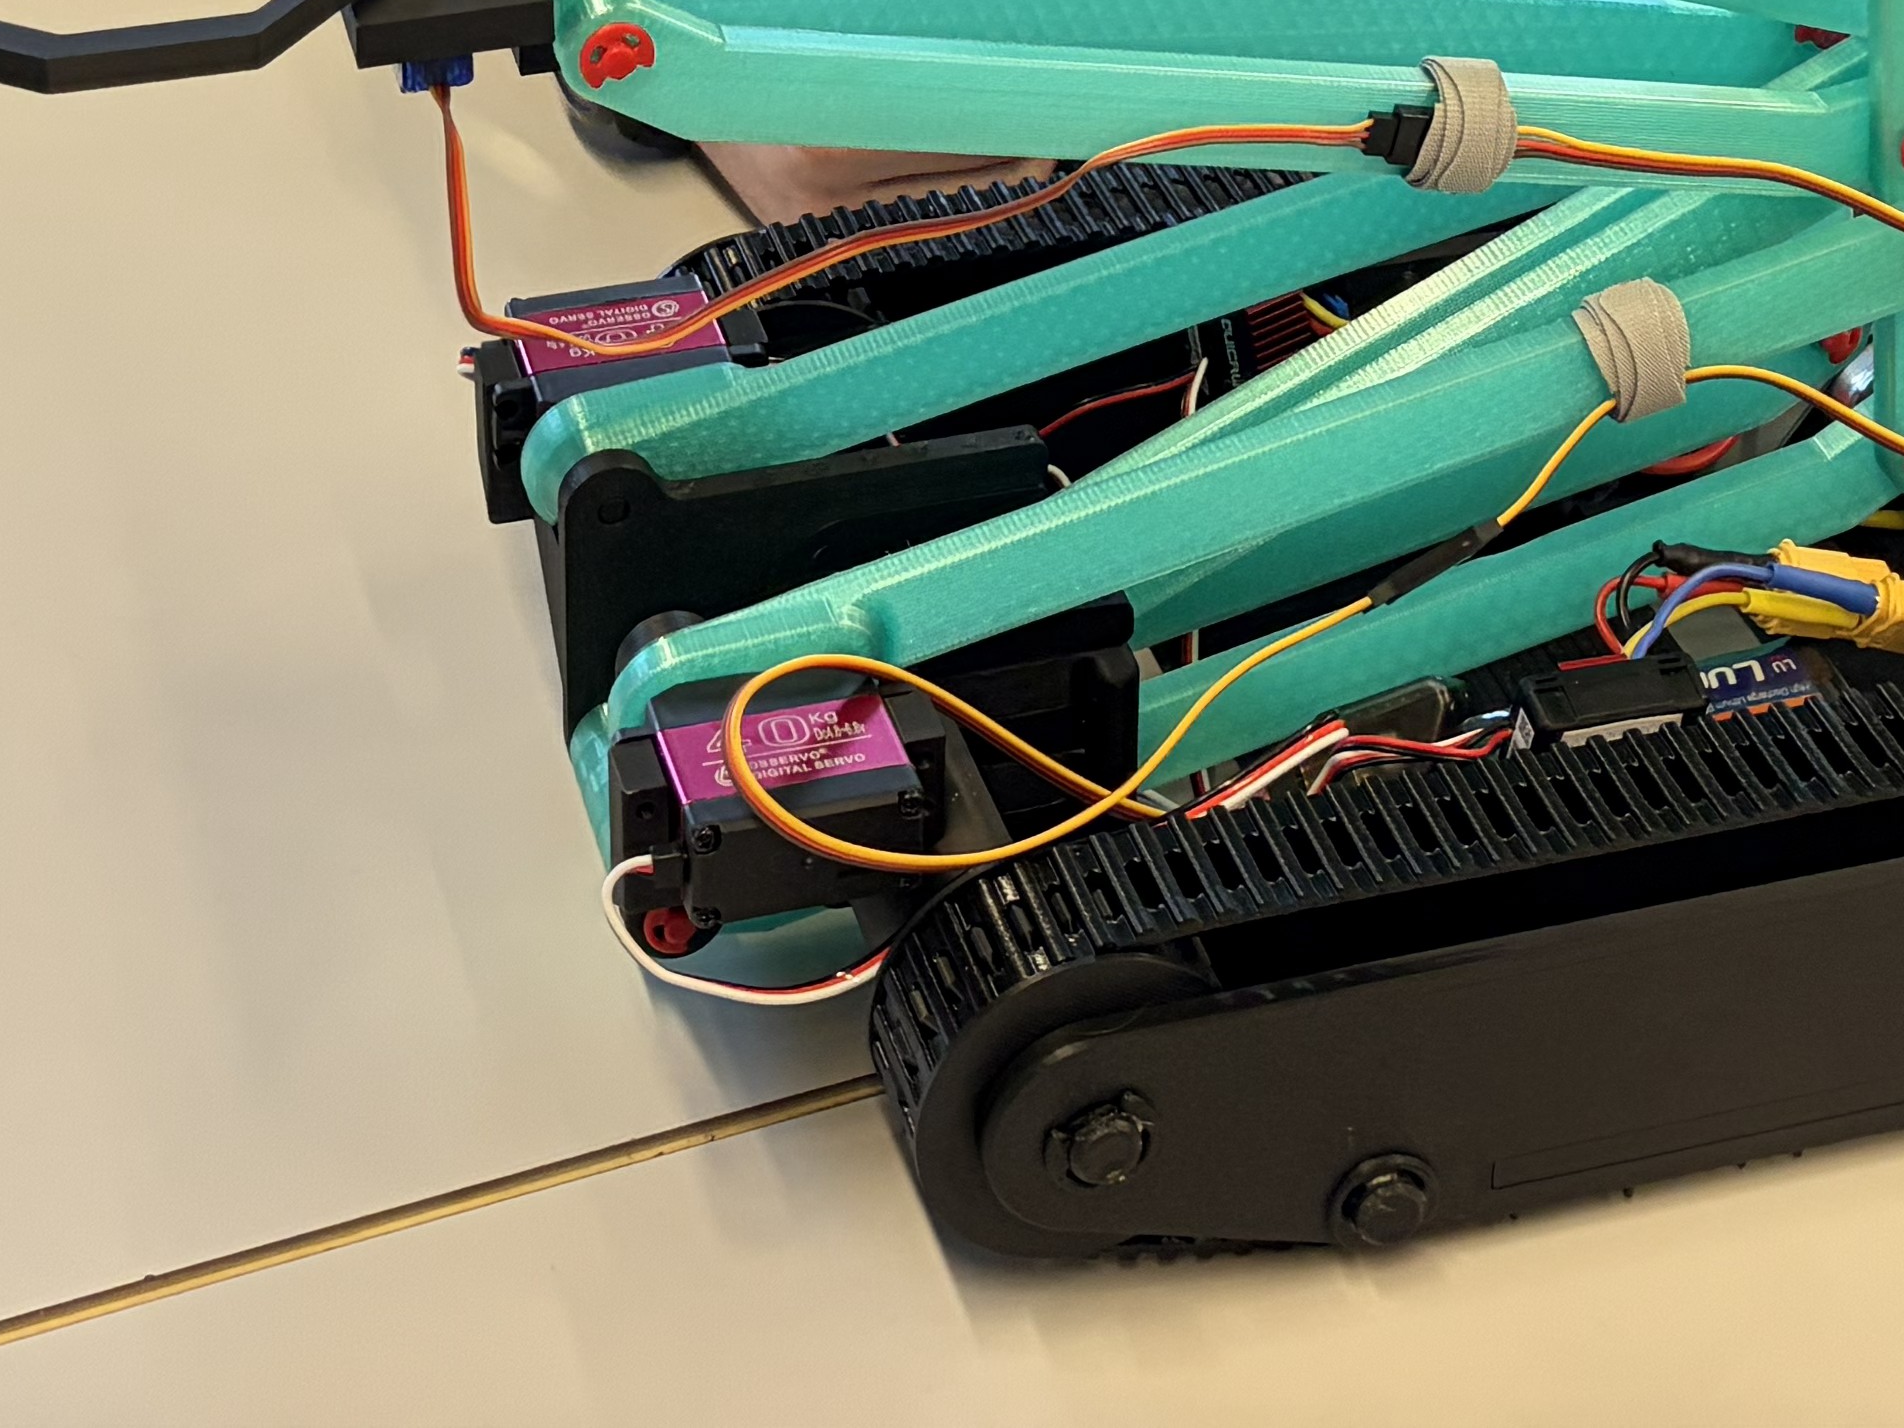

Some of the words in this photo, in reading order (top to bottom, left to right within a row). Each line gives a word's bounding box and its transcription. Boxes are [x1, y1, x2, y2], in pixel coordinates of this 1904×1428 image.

[1221, 318, 1241, 387] QUICRU
[1700, 659, 1765, 689] LU
[814, 752, 865, 771] SERVO
